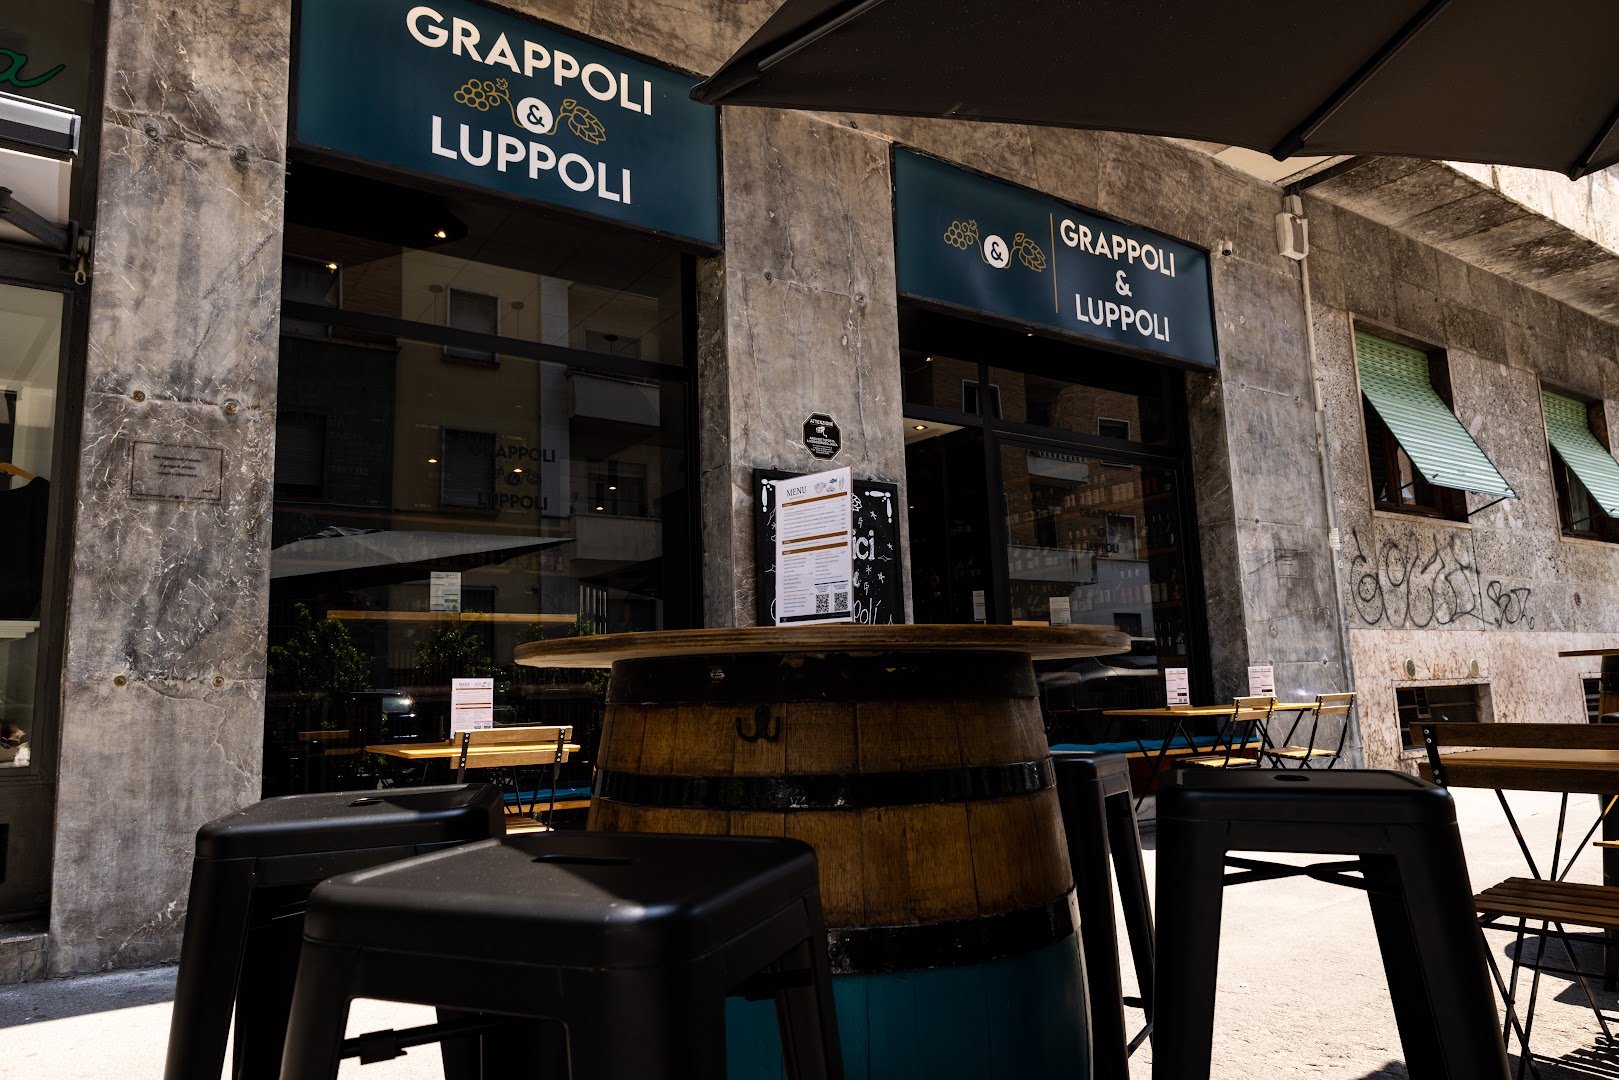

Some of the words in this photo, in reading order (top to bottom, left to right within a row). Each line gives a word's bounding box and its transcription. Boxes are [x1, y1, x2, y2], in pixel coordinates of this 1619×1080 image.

[406, 6, 652, 116] GRAPPOLI
[526, 104, 545, 128] &
[431, 114, 631, 205] LUPPOLI
[990, 241, 1003, 262] &
[1060, 218, 1176, 278] GRAPPOLI
[1115, 269, 1132, 297] &
[1075, 293, 1170, 342] LUPPOLI
[786, 486, 807, 497] MENU
[853, 529, 875, 561] ici
